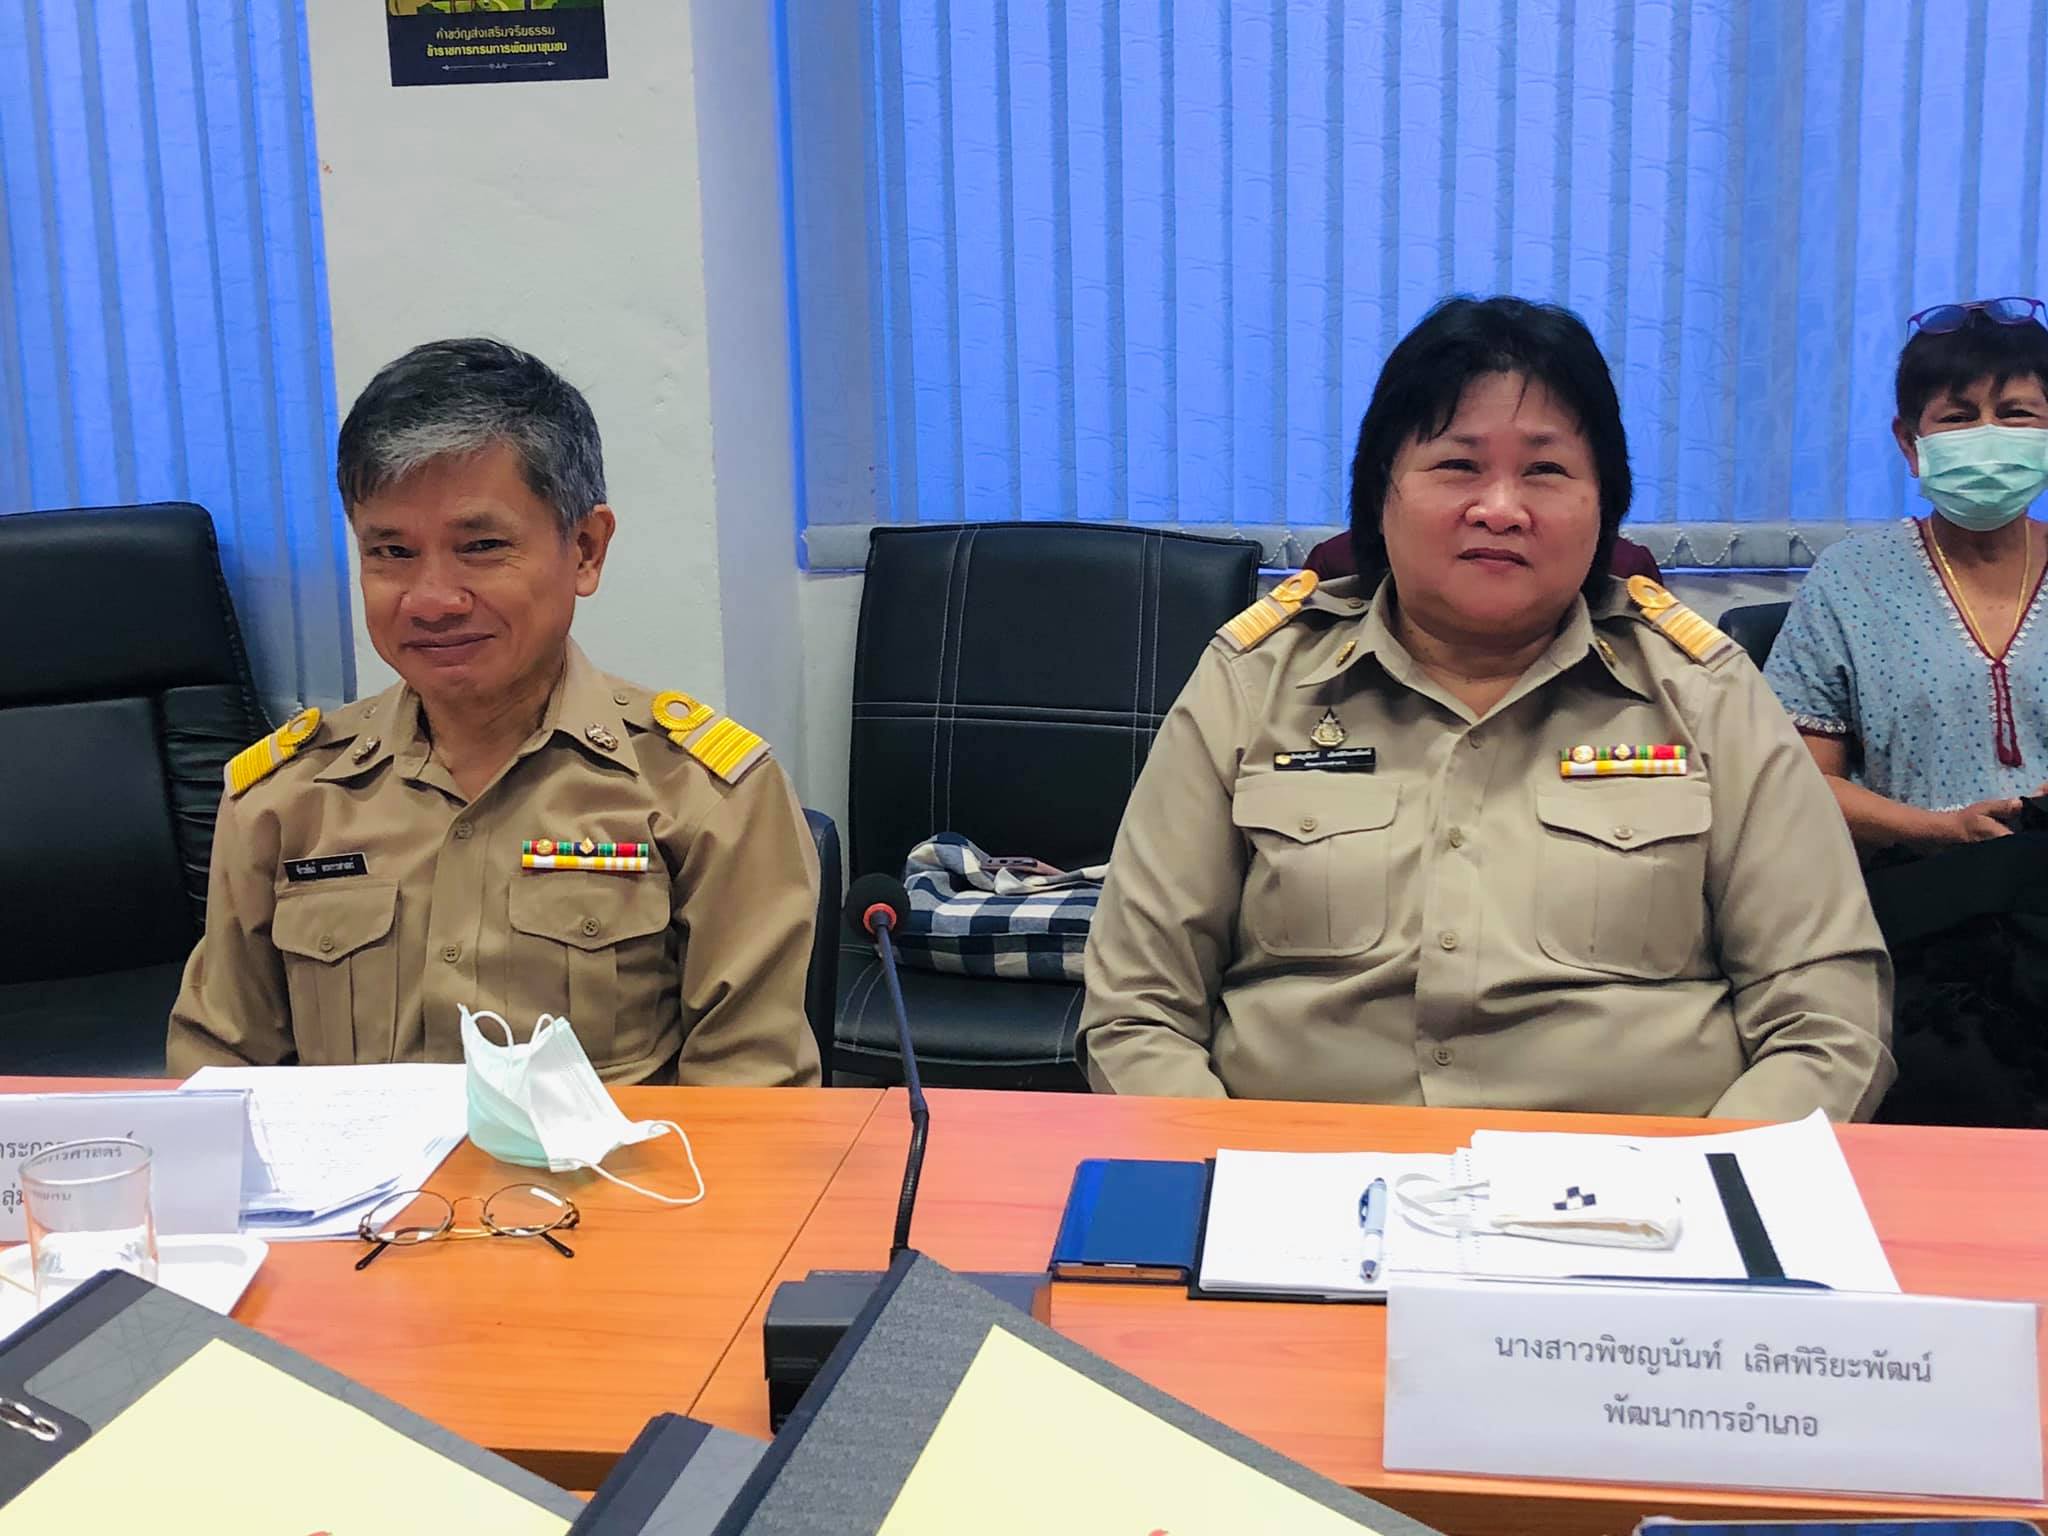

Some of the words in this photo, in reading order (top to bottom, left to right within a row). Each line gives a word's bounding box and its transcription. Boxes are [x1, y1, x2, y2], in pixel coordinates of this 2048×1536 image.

[436, 25, 556, 41] คำขวัญส่งเสริมจริยธรรม
[426, 41, 568, 57] ข้าราชการกรมการพัฒนาชุมชน
[1494, 1333, 1723, 1376] นางสาวพิชญนันท์
[1744, 1343, 1933, 1383] เลิศพิริยะพัฒน์
[1603, 1393, 1818, 1437] พัฒนาการอำเภอ
